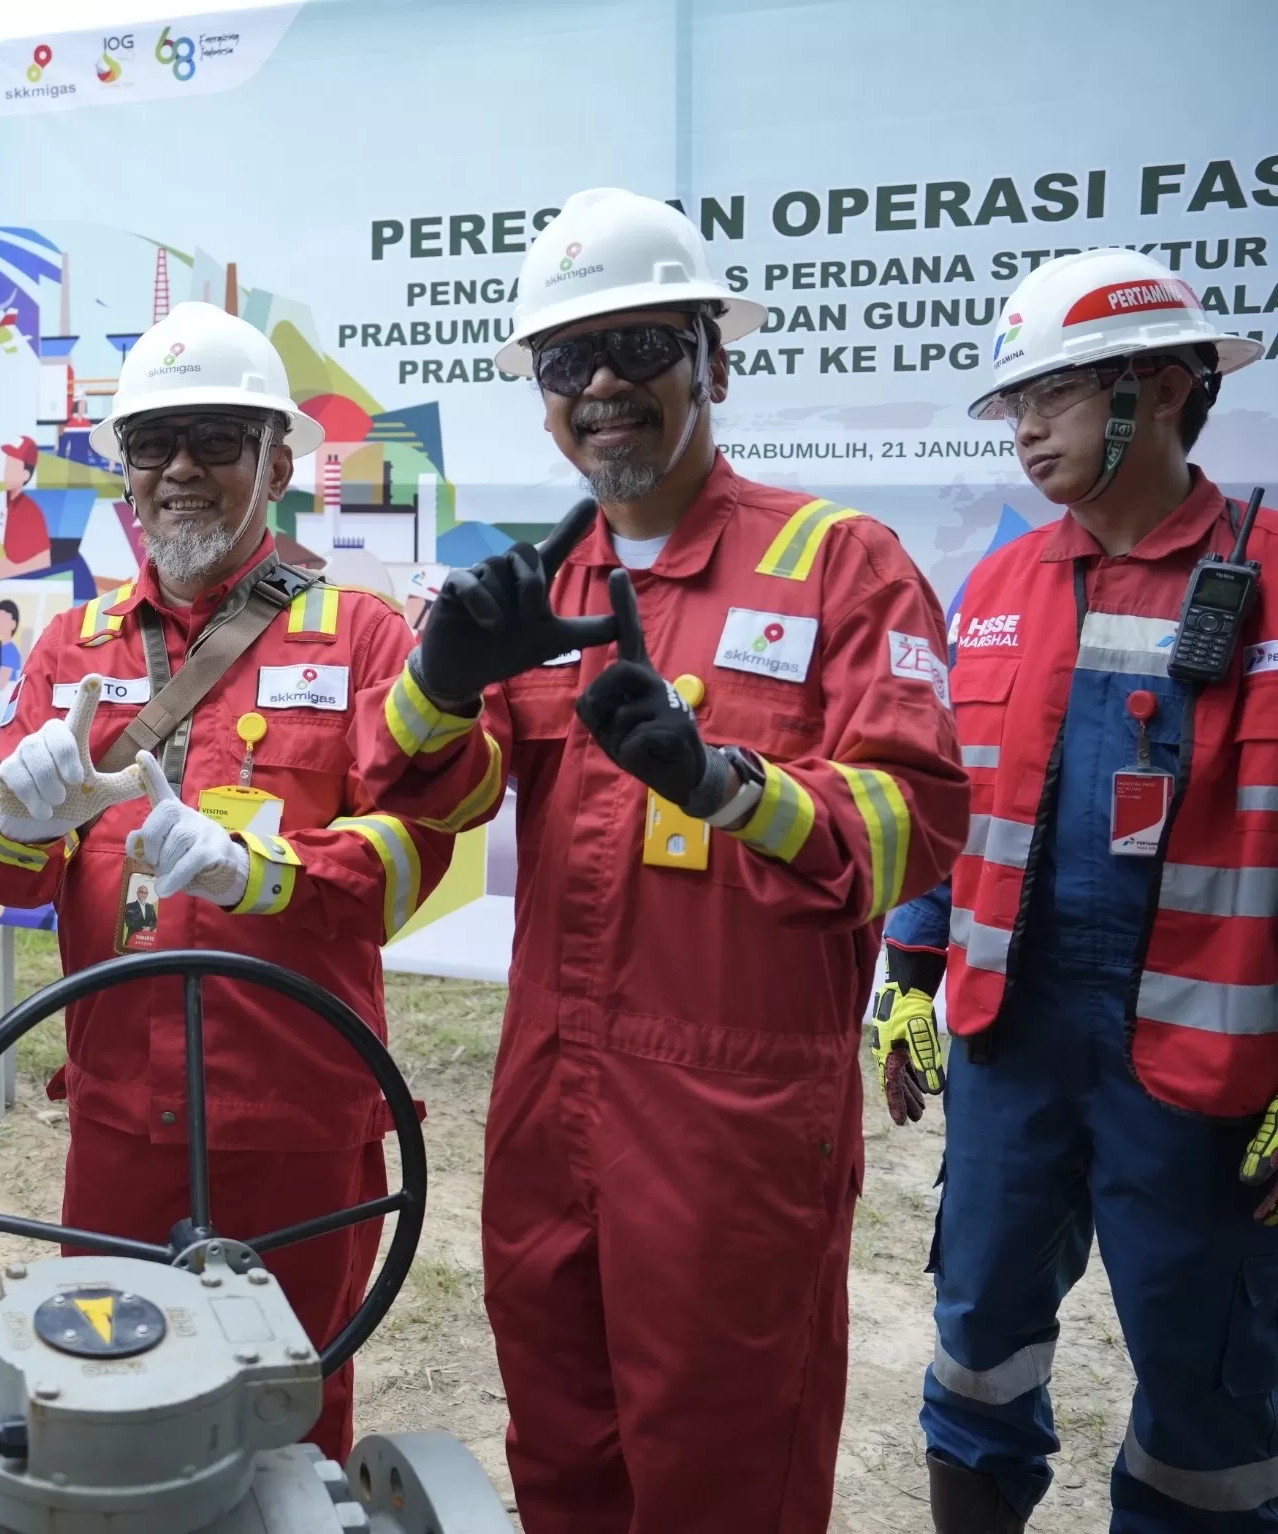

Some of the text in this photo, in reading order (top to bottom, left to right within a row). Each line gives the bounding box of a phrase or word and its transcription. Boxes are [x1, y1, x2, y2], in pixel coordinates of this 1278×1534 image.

[103, 34, 135, 51] IOG
[5, 81, 77, 100] skkmigas
[772, 170, 1106, 238] OPERASI
[1140, 154, 1278, 216] FAS
[545, 264, 604, 287] skkmigas
[764, 254, 975, 291] PERDANA
[1107, 285, 1183, 311] PERTAMINA
[820, 345, 877, 374] KE
[893, 342, 980, 372] LPG
[148, 364, 201, 378] skkmigas
[882, 441, 908, 458] 21
[968, 614, 1020, 635] HSSE
[958, 633, 1019, 648] MARSHAL
[723, 648, 799, 673] skkmigas
[269, 690, 336, 705] skkmigas
[202, 807, 228, 816] VISITOR
